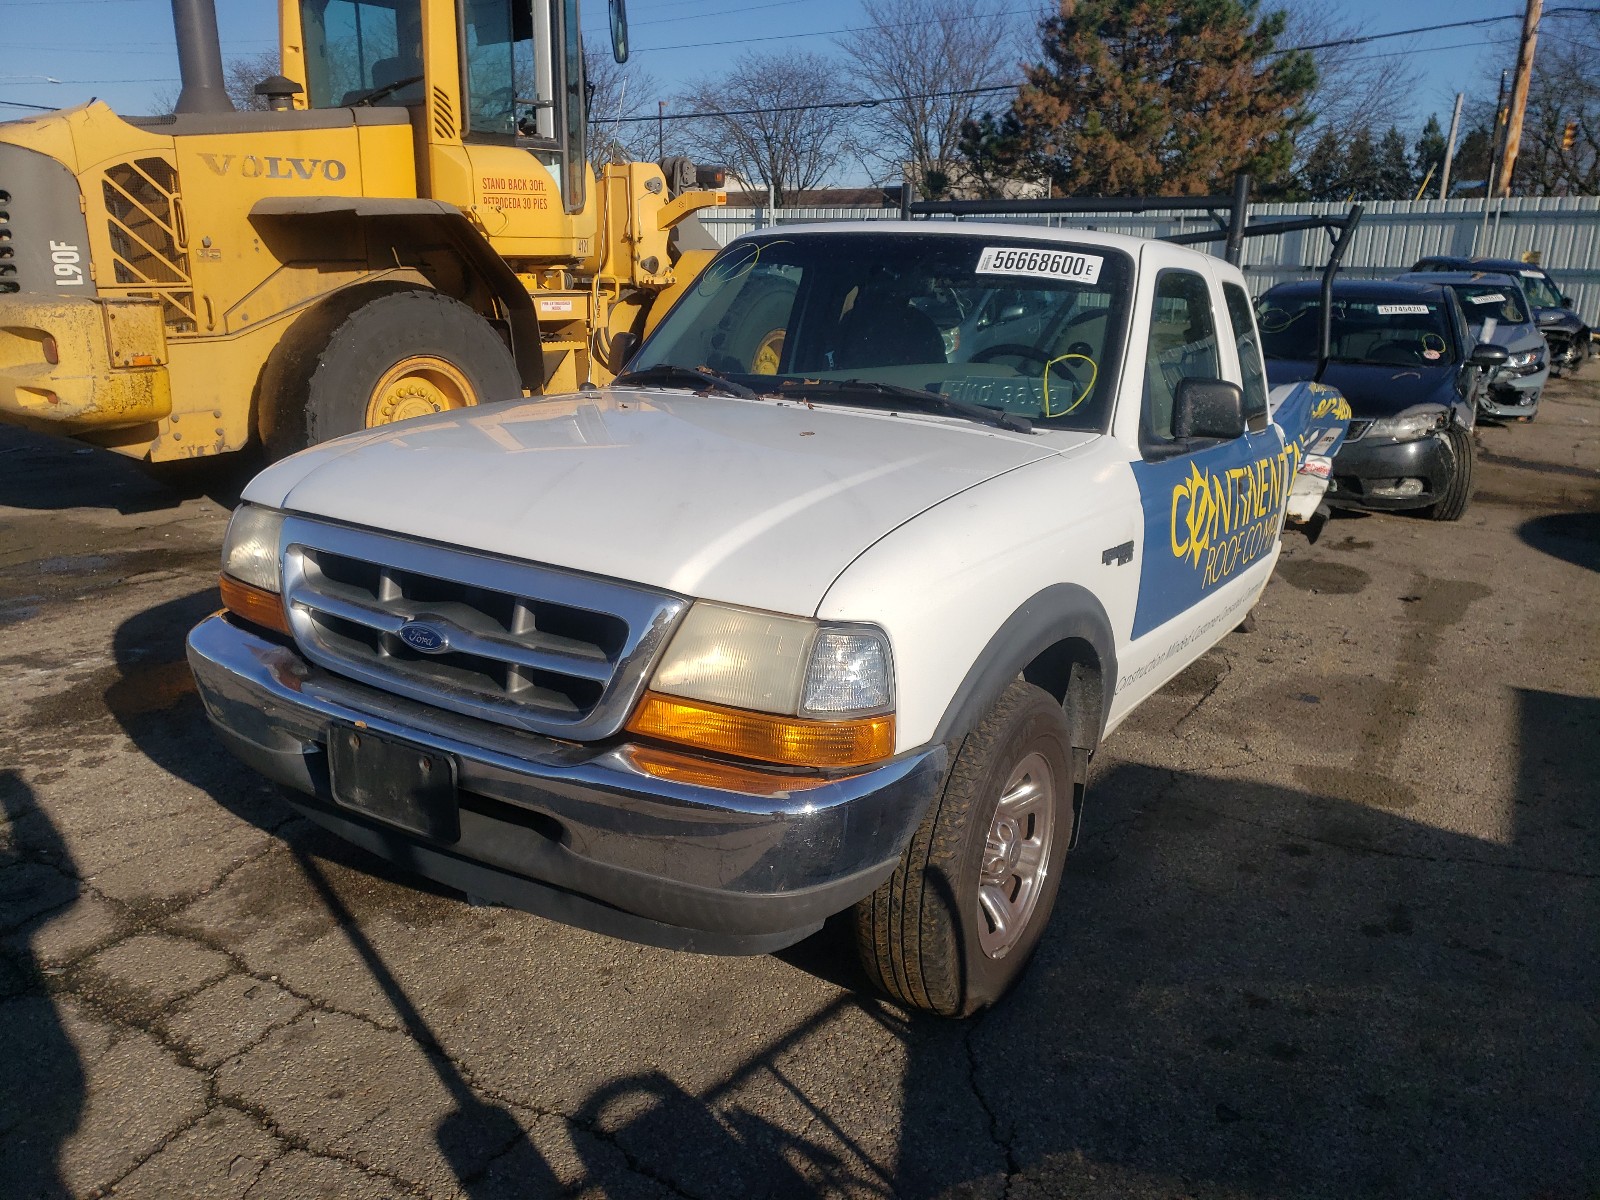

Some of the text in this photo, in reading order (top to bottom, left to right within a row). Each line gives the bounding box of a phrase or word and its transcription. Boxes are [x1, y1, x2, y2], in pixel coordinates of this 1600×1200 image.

[197, 153, 346, 181] VOLVO
[482, 178, 506, 190] STAND
[508, 180, 528, 191] BACK
[522, 197, 531, 209] 30
[533, 198, 548, 210] PIES
[49, 240, 84, 286] L90F
[993, 251, 1086, 276] 56668600
[1201, 531, 1245, 590] ROOF
[409, 628, 434, 647] Ford
